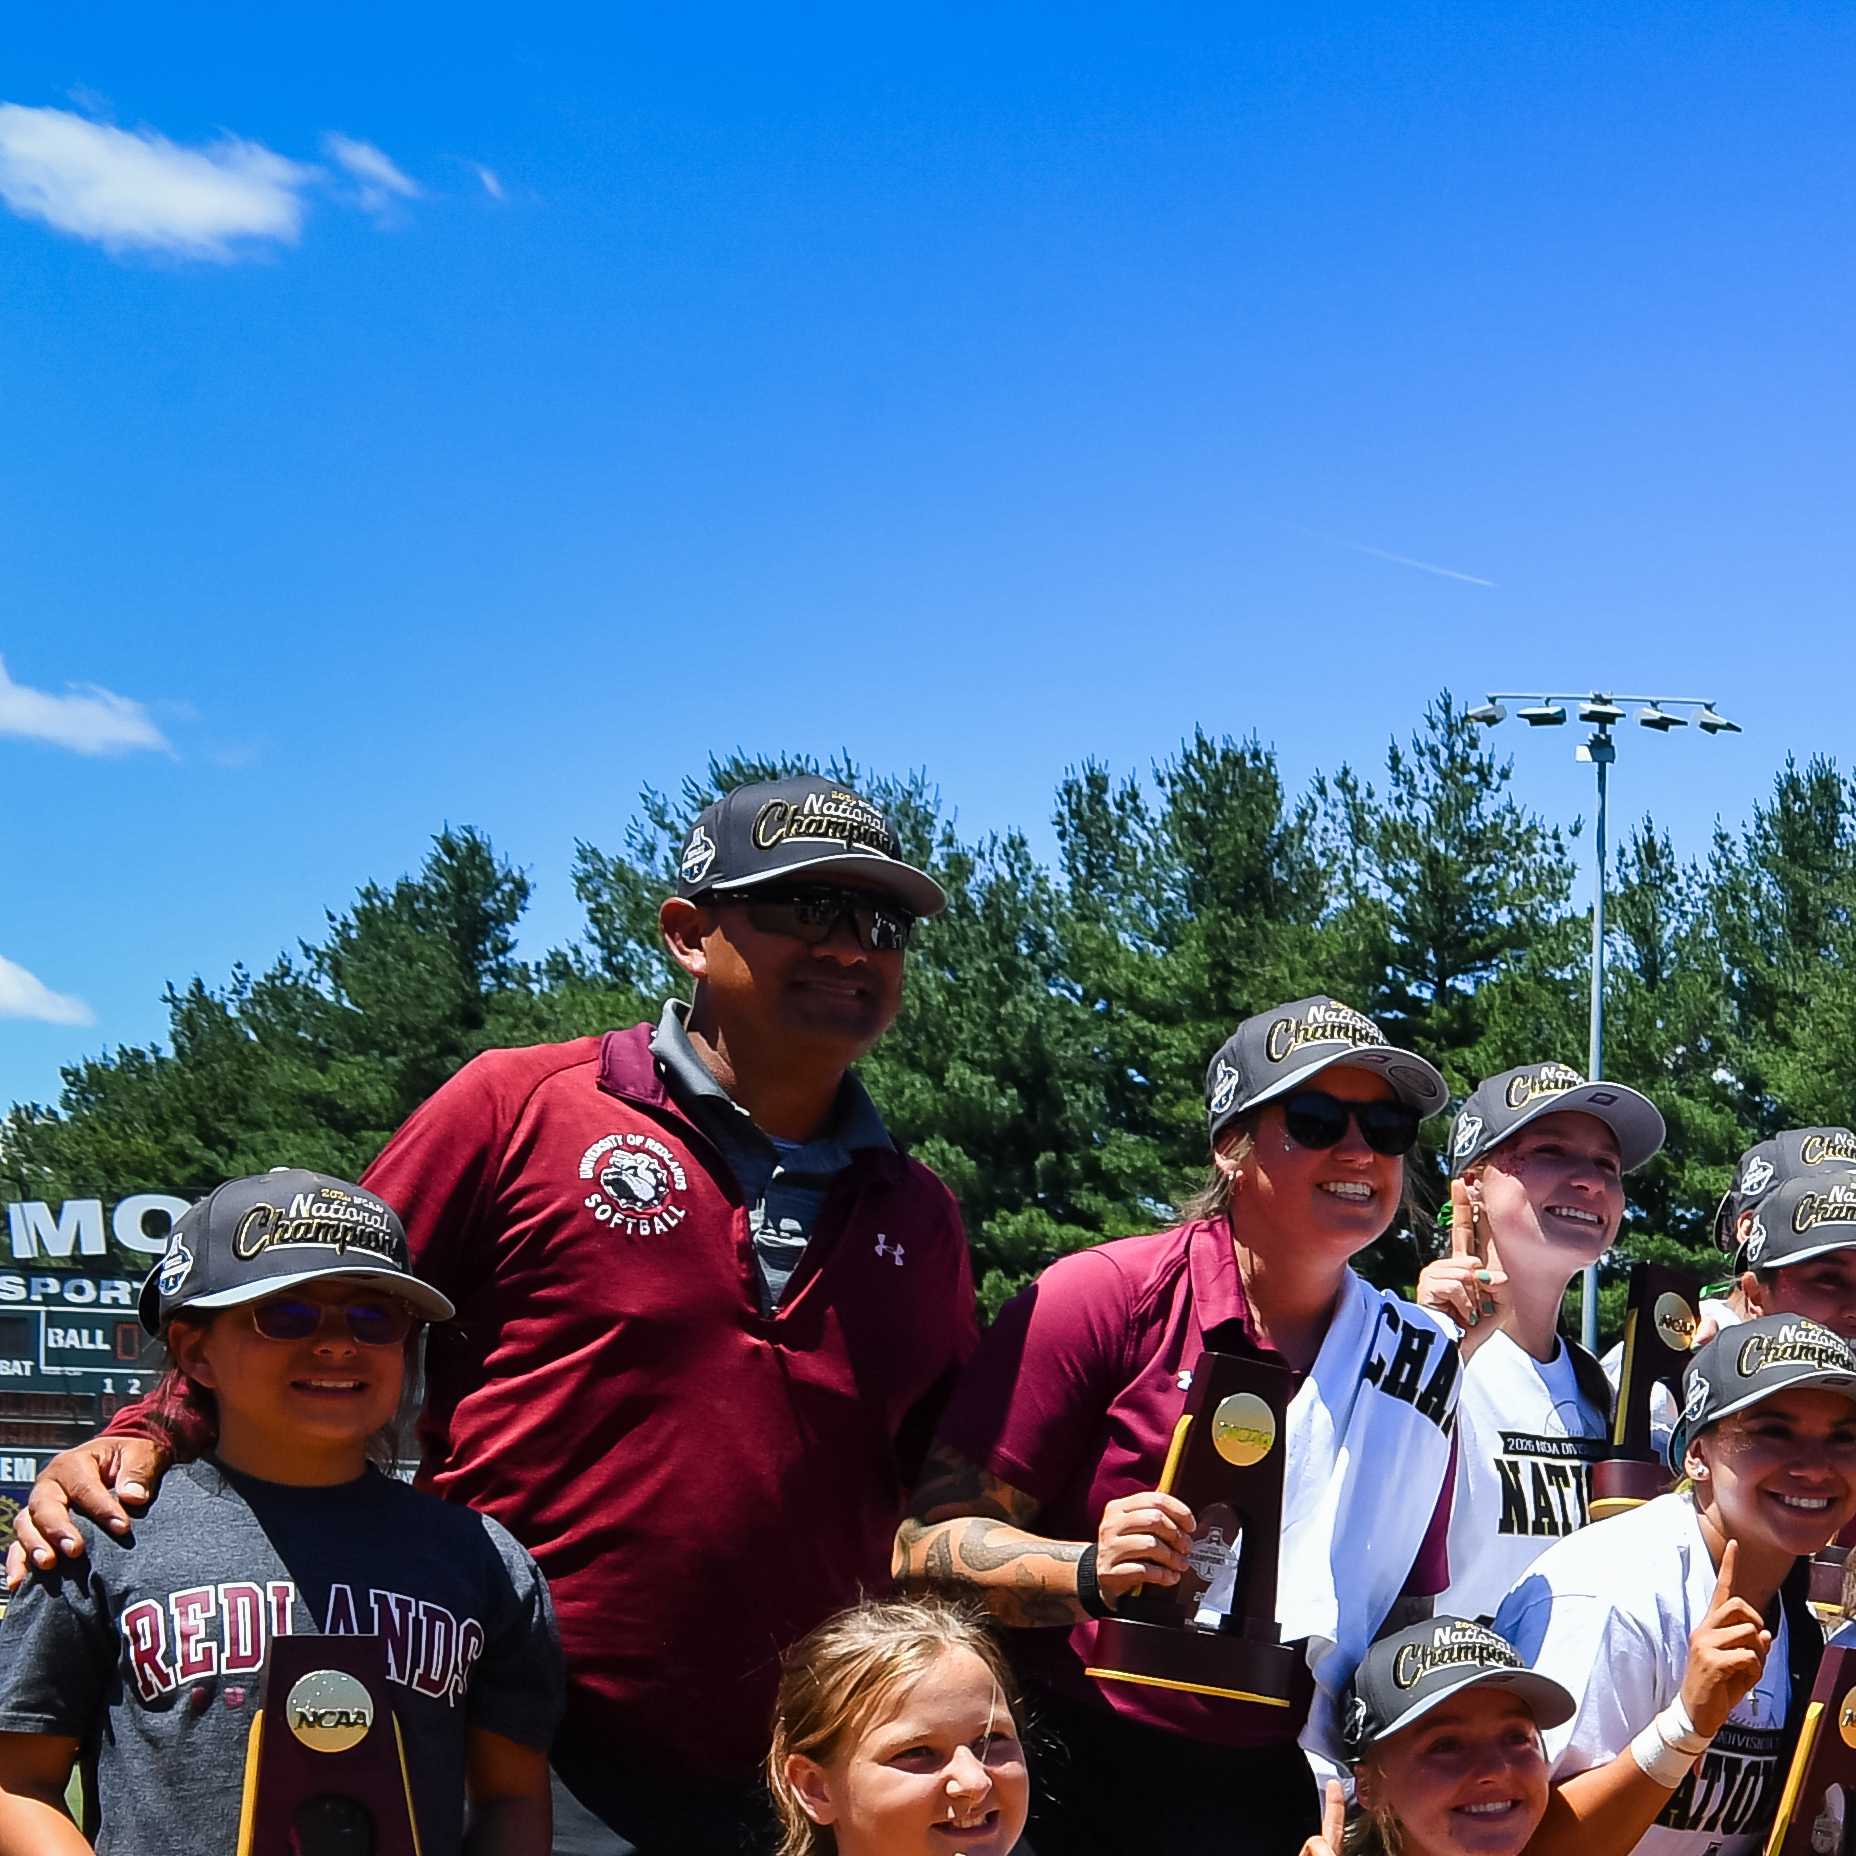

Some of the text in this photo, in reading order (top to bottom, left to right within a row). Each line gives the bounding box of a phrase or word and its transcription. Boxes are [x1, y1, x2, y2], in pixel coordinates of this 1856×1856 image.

[803, 793, 888, 835] National
[580, 1134, 687, 1190] UNIVERSITY OF REDLANDS
[288, 1193, 391, 1233] National
[585, 1194, 686, 1235] SOFTBALL
[0, 1276, 142, 1304] SPOR
[47, 1328, 111, 1350] BALL
[103, 1379, 142, 1395] 1 2
[1358, 1301, 1460, 1437] CHA
[294, 1709, 370, 1729] NCAA
